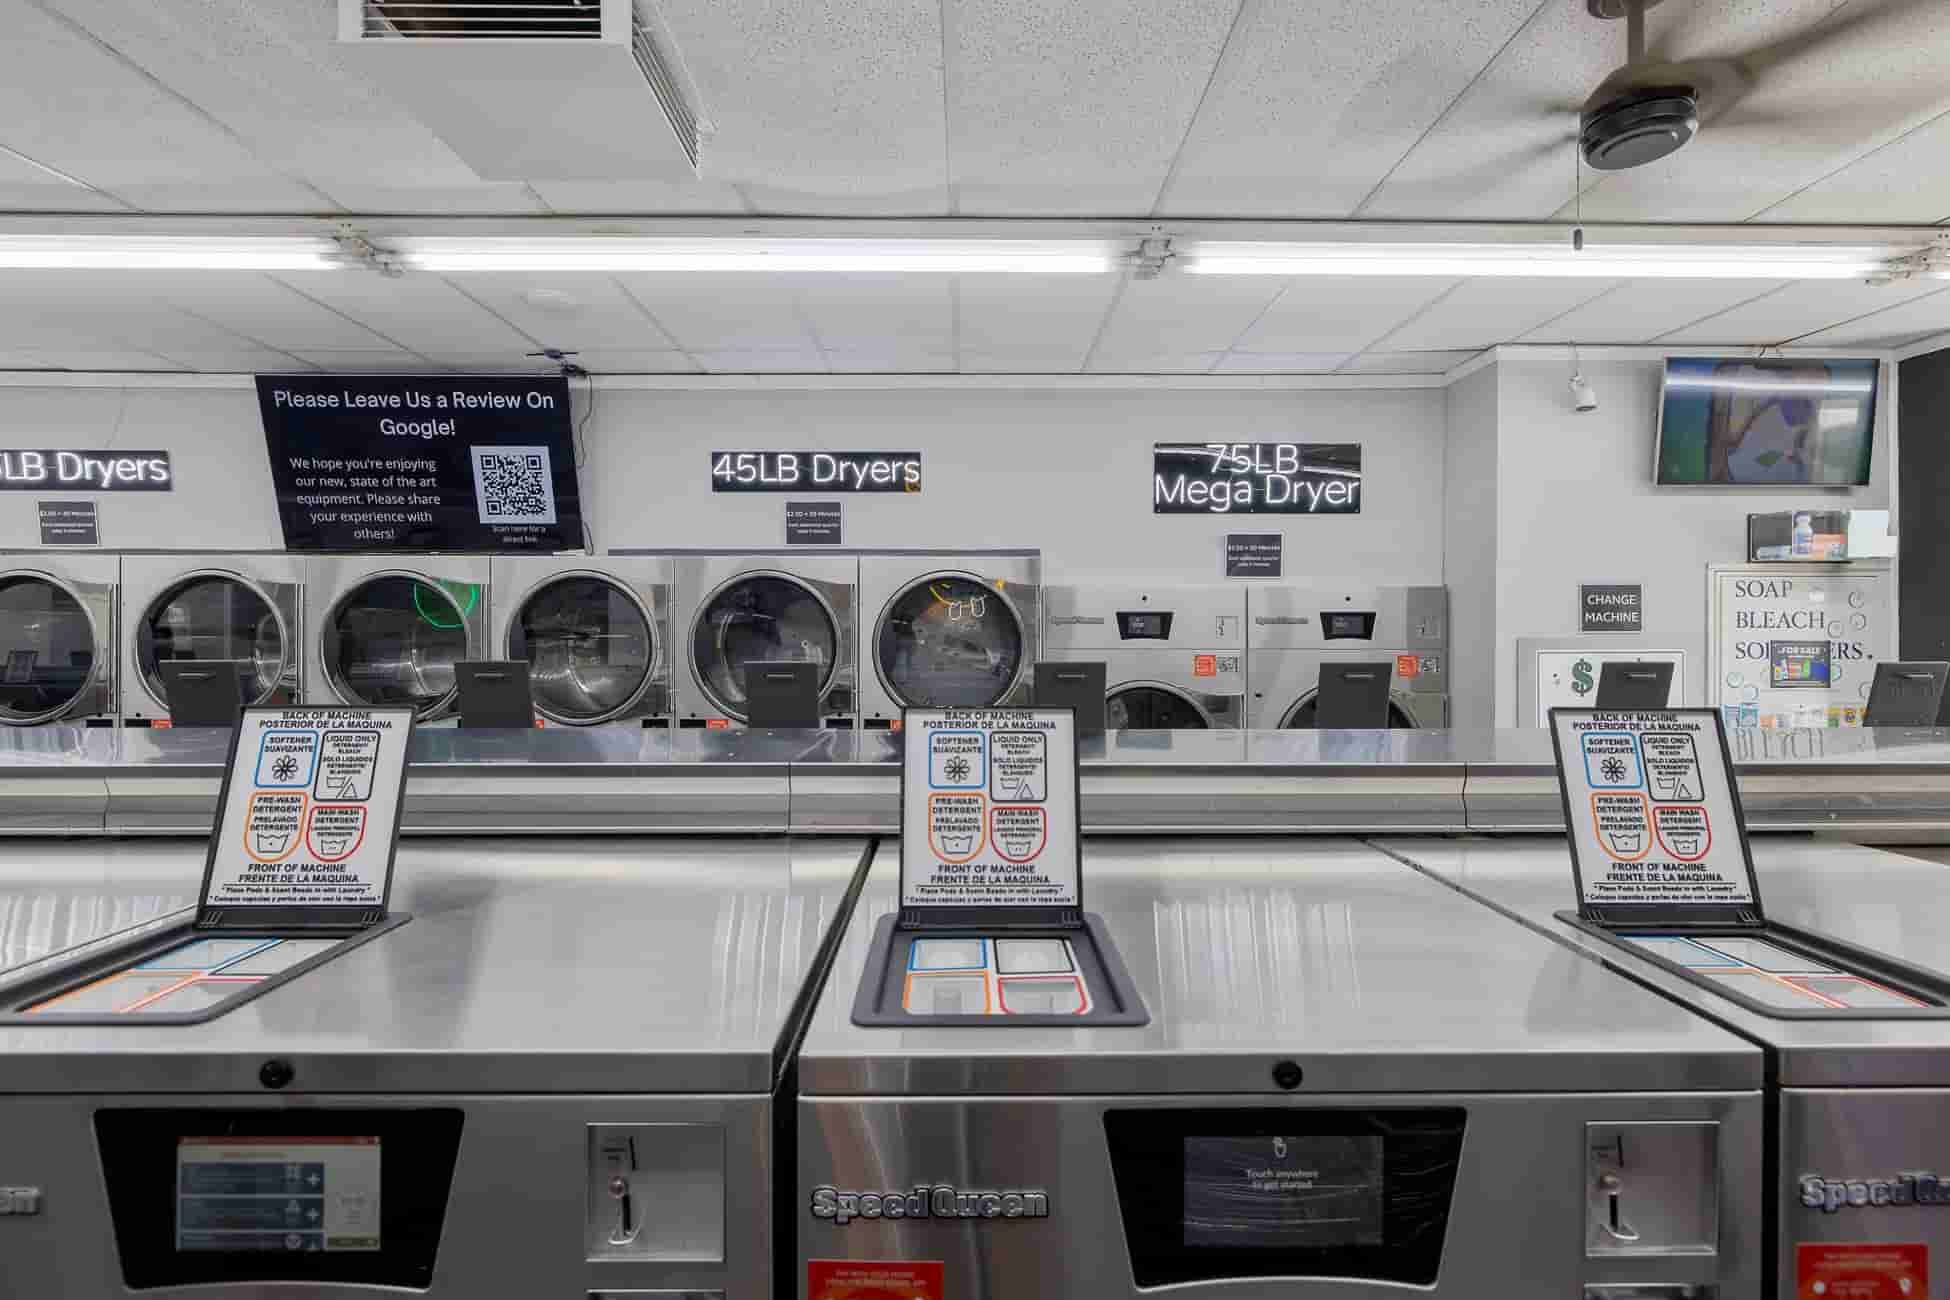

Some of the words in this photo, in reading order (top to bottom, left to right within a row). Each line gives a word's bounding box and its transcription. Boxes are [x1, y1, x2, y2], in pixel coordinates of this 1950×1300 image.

[274, 390, 340, 410] Please
[344, 390, 401, 410] Leave
[406, 391, 432, 410] Us
[436, 395, 448, 410] a
[453, 391, 520, 410] Review
[527, 391, 554, 410] On
[380, 418, 456, 439] Google!
[290, 458, 311, 470] We
[313, 457, 343, 473] hope
[345, 458, 383, 473] you're
[385, 457, 437, 473] enjoying
[1206, 444, 1299, 474] 75LB
[0, 452, 45, 481] LB
[56, 452, 169, 489] Dryers
[713, 453, 800, 483] 45LB
[813, 453, 920, 489] Dryers
[296, 477, 317, 488] our
[320, 477, 347, 489] new,
[350, 476, 379, 488] state
[382, 475, 395, 488] of
[397, 475, 417, 488] the
[419, 476, 437, 488] art
[296, 492, 364, 506] equipment.
[367, 493, 405, 505] Please
[408, 493, 441, 505] share
[1155, 474, 1252, 512] Mega
[1266, 474, 1361, 512] Dryer
[310, 513, 338, 525] your
[341, 512, 404, 525] experience
[407, 511, 432, 523] with
[353, 526, 395, 540] others!
[1735, 580, 1793, 598] SOAP
[1587, 594, 1637, 605] CHANGE
[1585, 611, 1640, 623] MACHINE
[1736, 611, 1825, 629] BLEACH
[923, 720, 978, 728] POSTERIOR
[981, 720, 993, 728] DE
[991, 712, 1033, 720] MACHINE
[247, 863, 282, 871] FRONT
[283, 863, 299, 871] OF
[300, 863, 346, 872] MACHINE
[812, 1185, 930, 1225] Speed
[931, 1185, 1048, 1219] Queen
